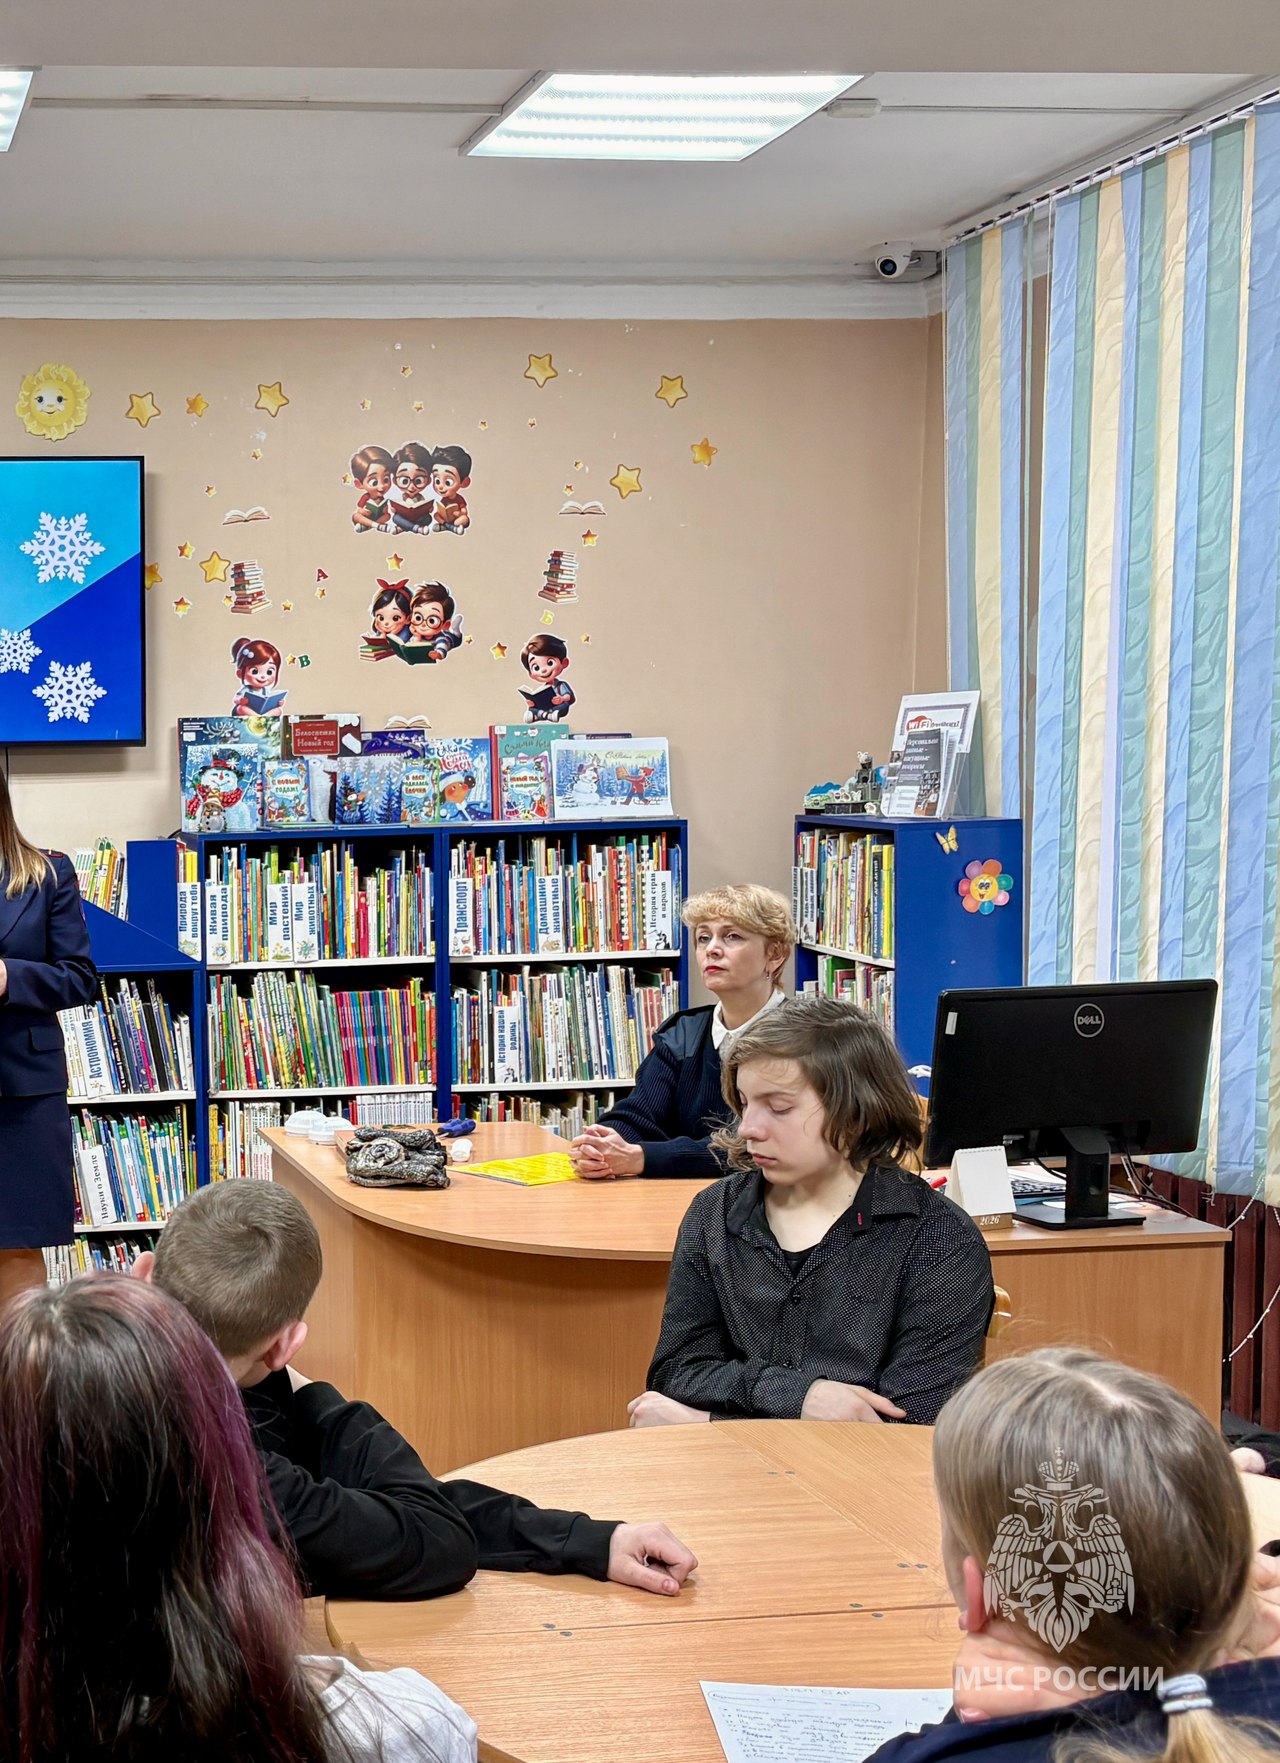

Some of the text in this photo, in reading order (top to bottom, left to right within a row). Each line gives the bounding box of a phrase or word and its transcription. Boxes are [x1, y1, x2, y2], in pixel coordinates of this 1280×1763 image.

[297, 739, 322, 747] Новый
[179, 890, 187, 932] Природа
[190, 884, 198, 904] тебя
[209, 894, 218, 935] Живая
[221, 887, 229, 941] природа
[268, 901, 278, 926] Мир
[281, 885, 291, 941] растений
[294, 901, 304, 921] Мир
[307, 885, 316, 936] животных
[454, 880, 468, 934] Транспорт
[538, 878, 549, 934] Домашние
[551, 878, 560, 933] животные
[650, 896, 658, 928] История
[497, 1010, 506, 1064] История нашей
[1077, 1015, 1101, 1025] DELL
[82, 1020, 102, 1079] Астрономия
[91, 1155, 102, 1183] Земле
[98, 1191, 108, 1220] Науки
